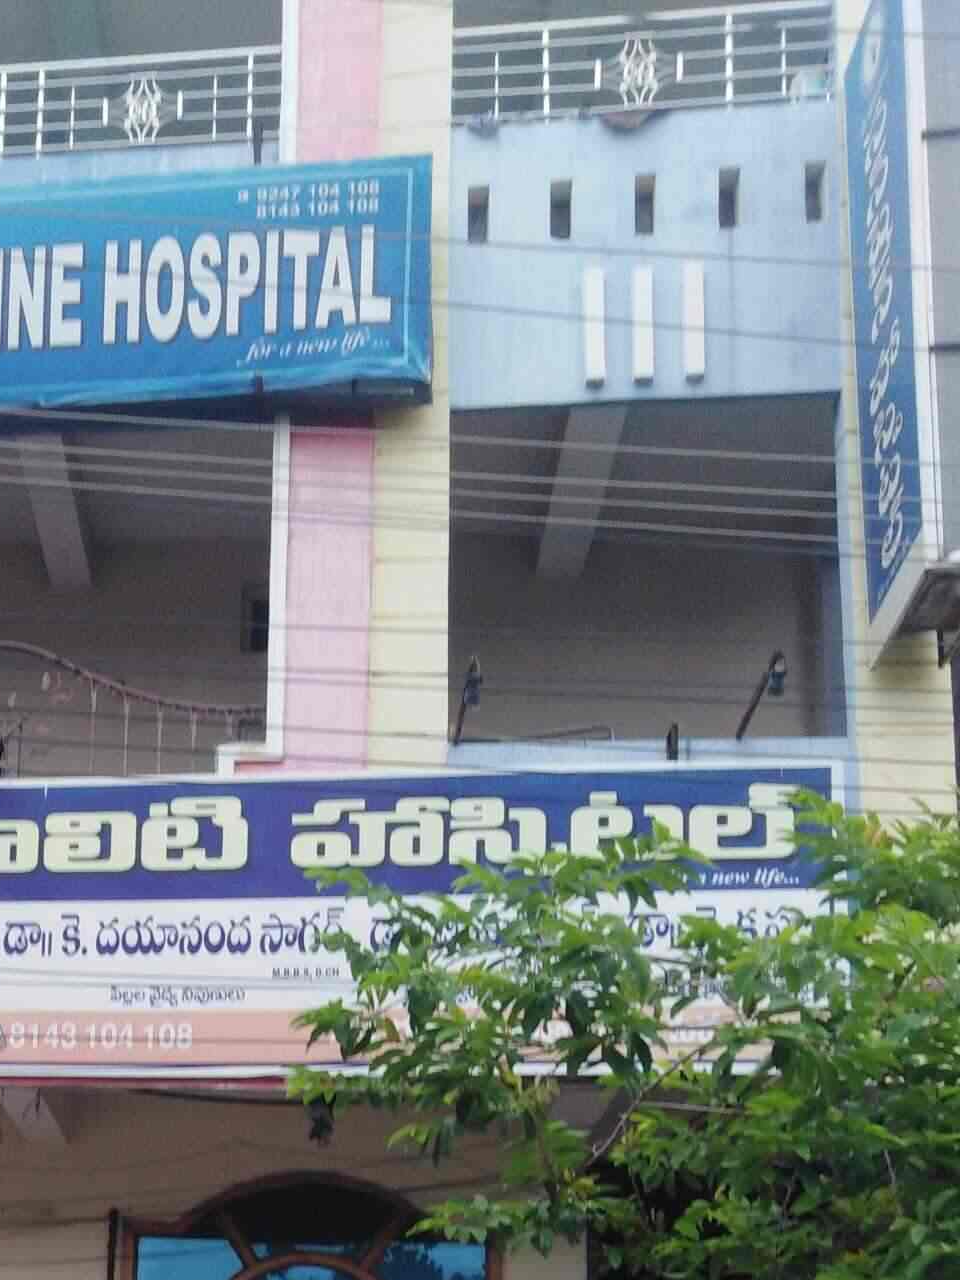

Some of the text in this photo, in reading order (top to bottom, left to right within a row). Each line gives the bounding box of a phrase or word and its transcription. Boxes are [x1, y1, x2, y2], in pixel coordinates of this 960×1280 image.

[103, 223, 393, 346] HOSPITAL
[711, 871, 750, 886] new
[95, 915, 252, 957] దయానంద
[8, 1022, 194, 1049] 8143 104 108
